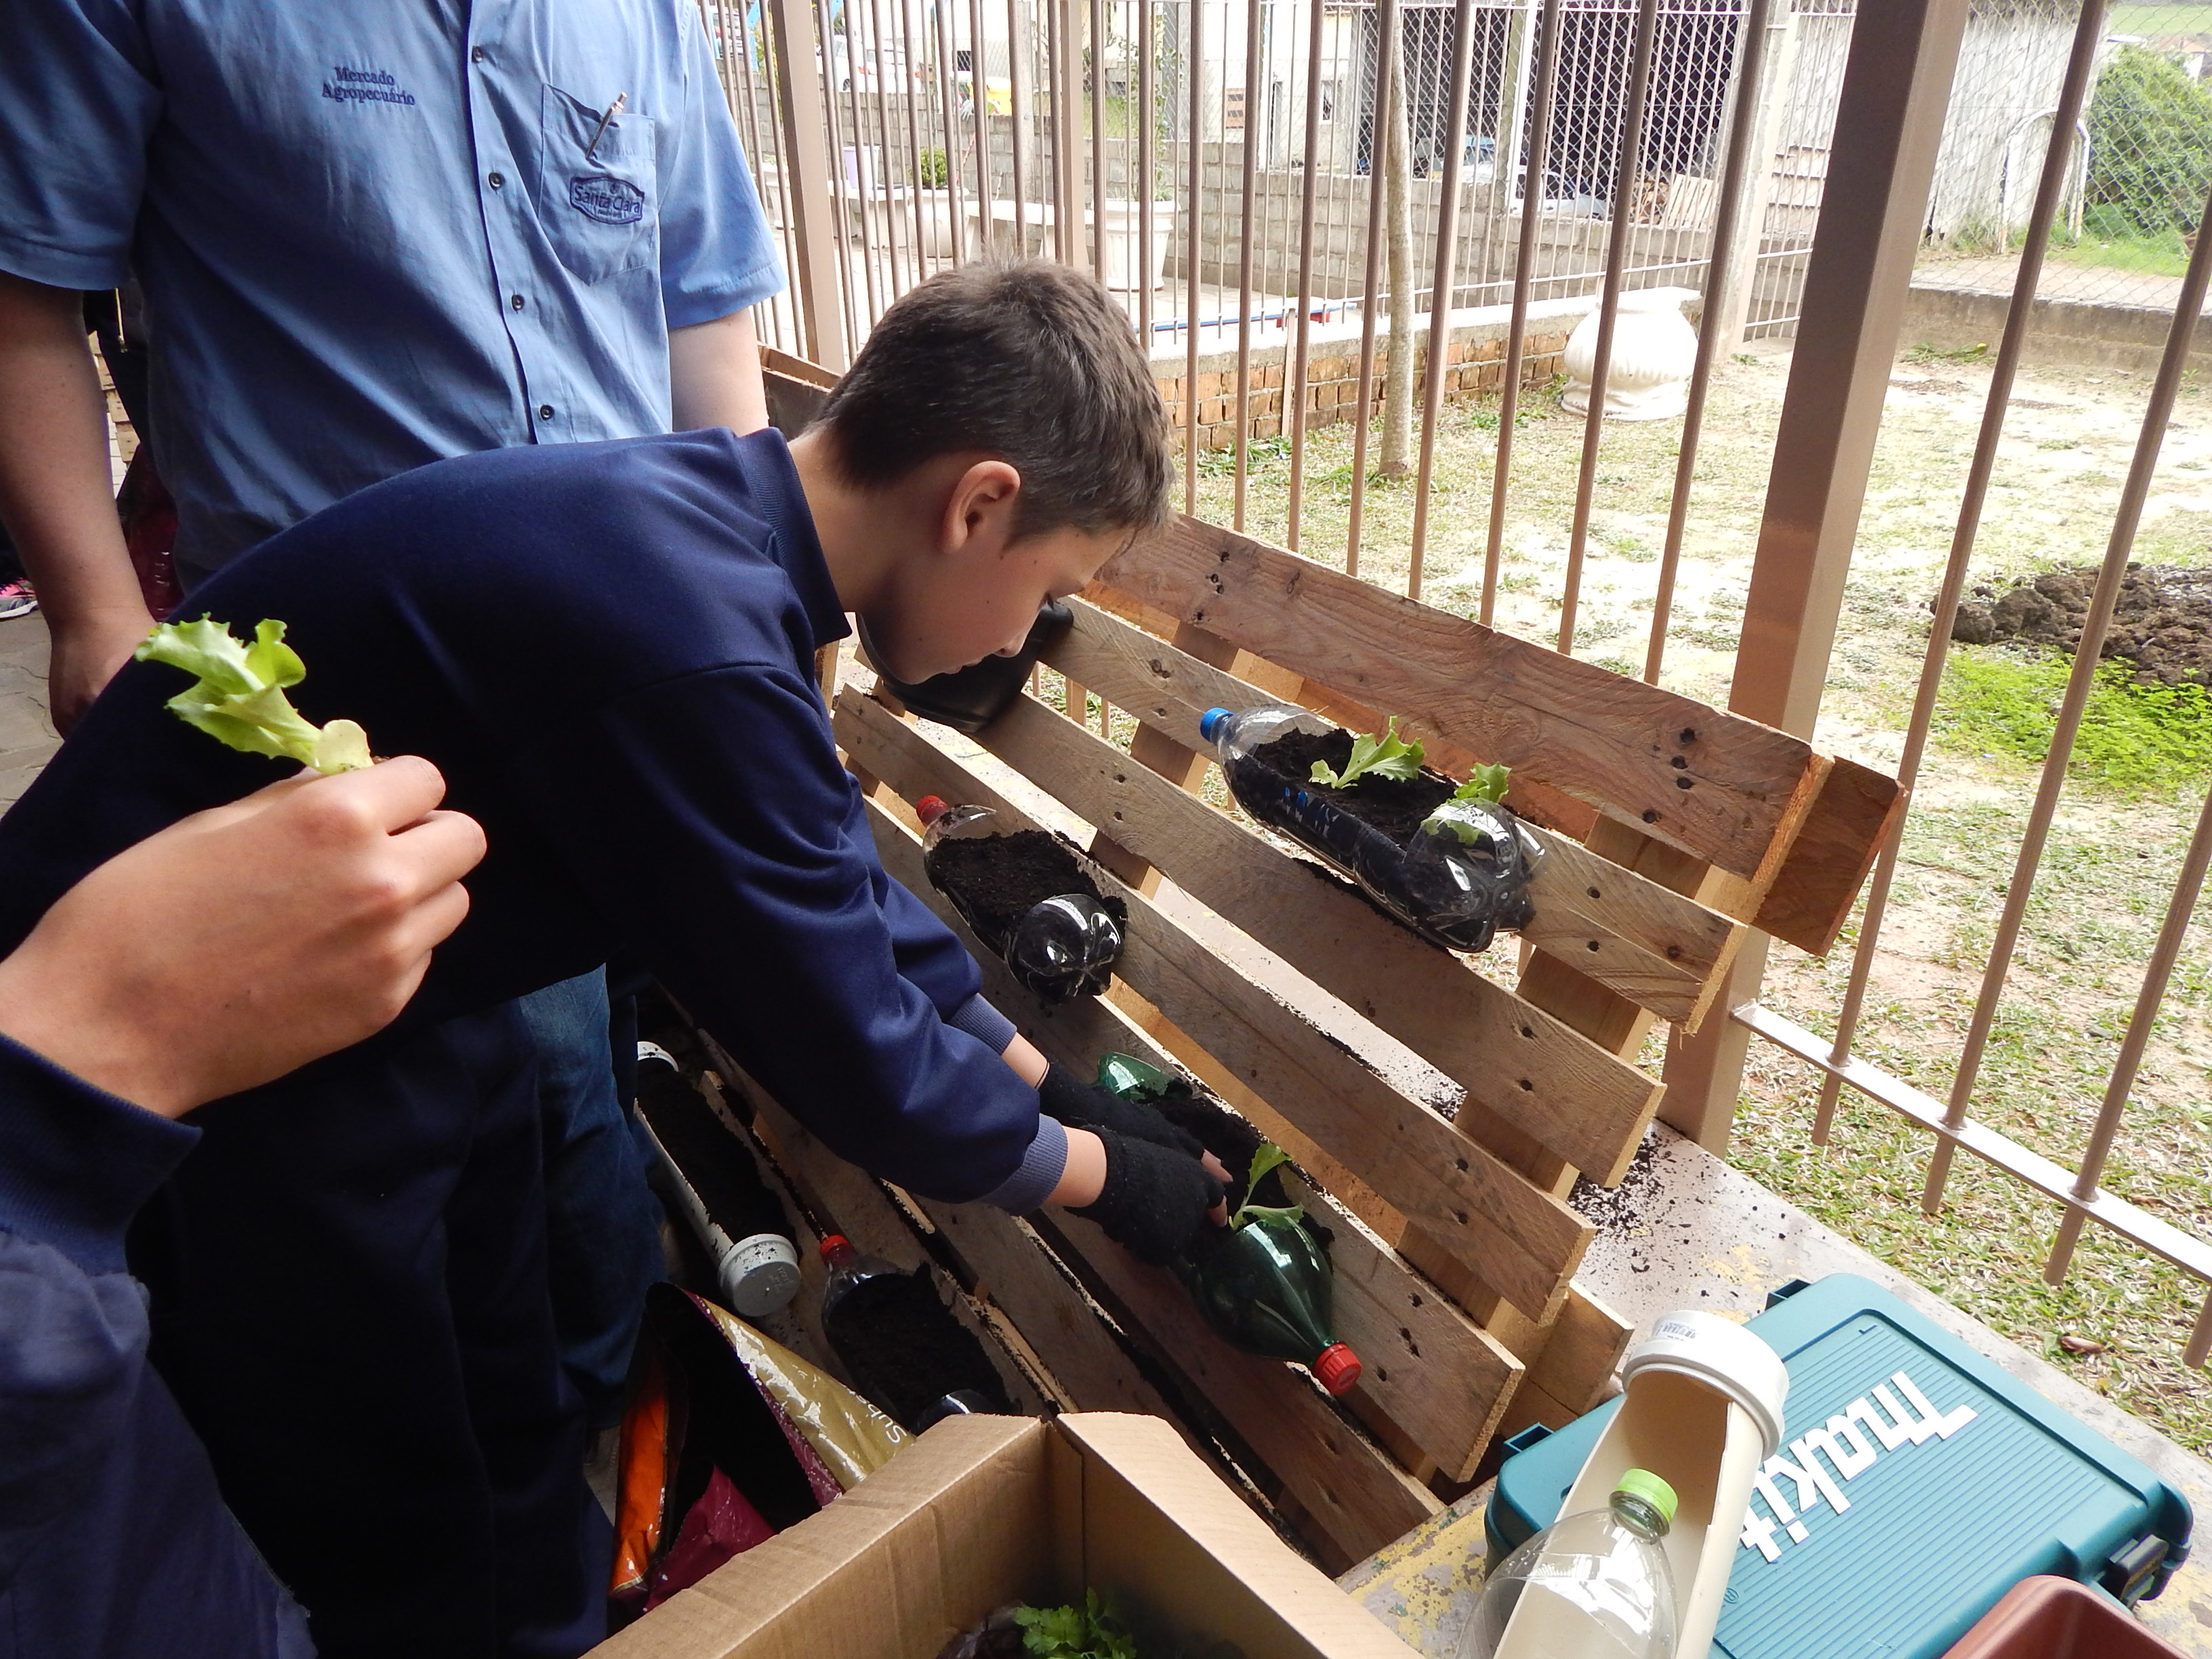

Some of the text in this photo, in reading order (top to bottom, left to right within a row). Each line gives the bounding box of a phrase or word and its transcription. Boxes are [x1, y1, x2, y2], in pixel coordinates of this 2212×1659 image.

[335, 66, 394, 85] Mercado
[322, 82, 415, 105] Agropecuário
[574, 184, 611, 209] Santa
[613, 195, 640, 213] Clara
[1740, 1370, 1979, 1563] Makit
